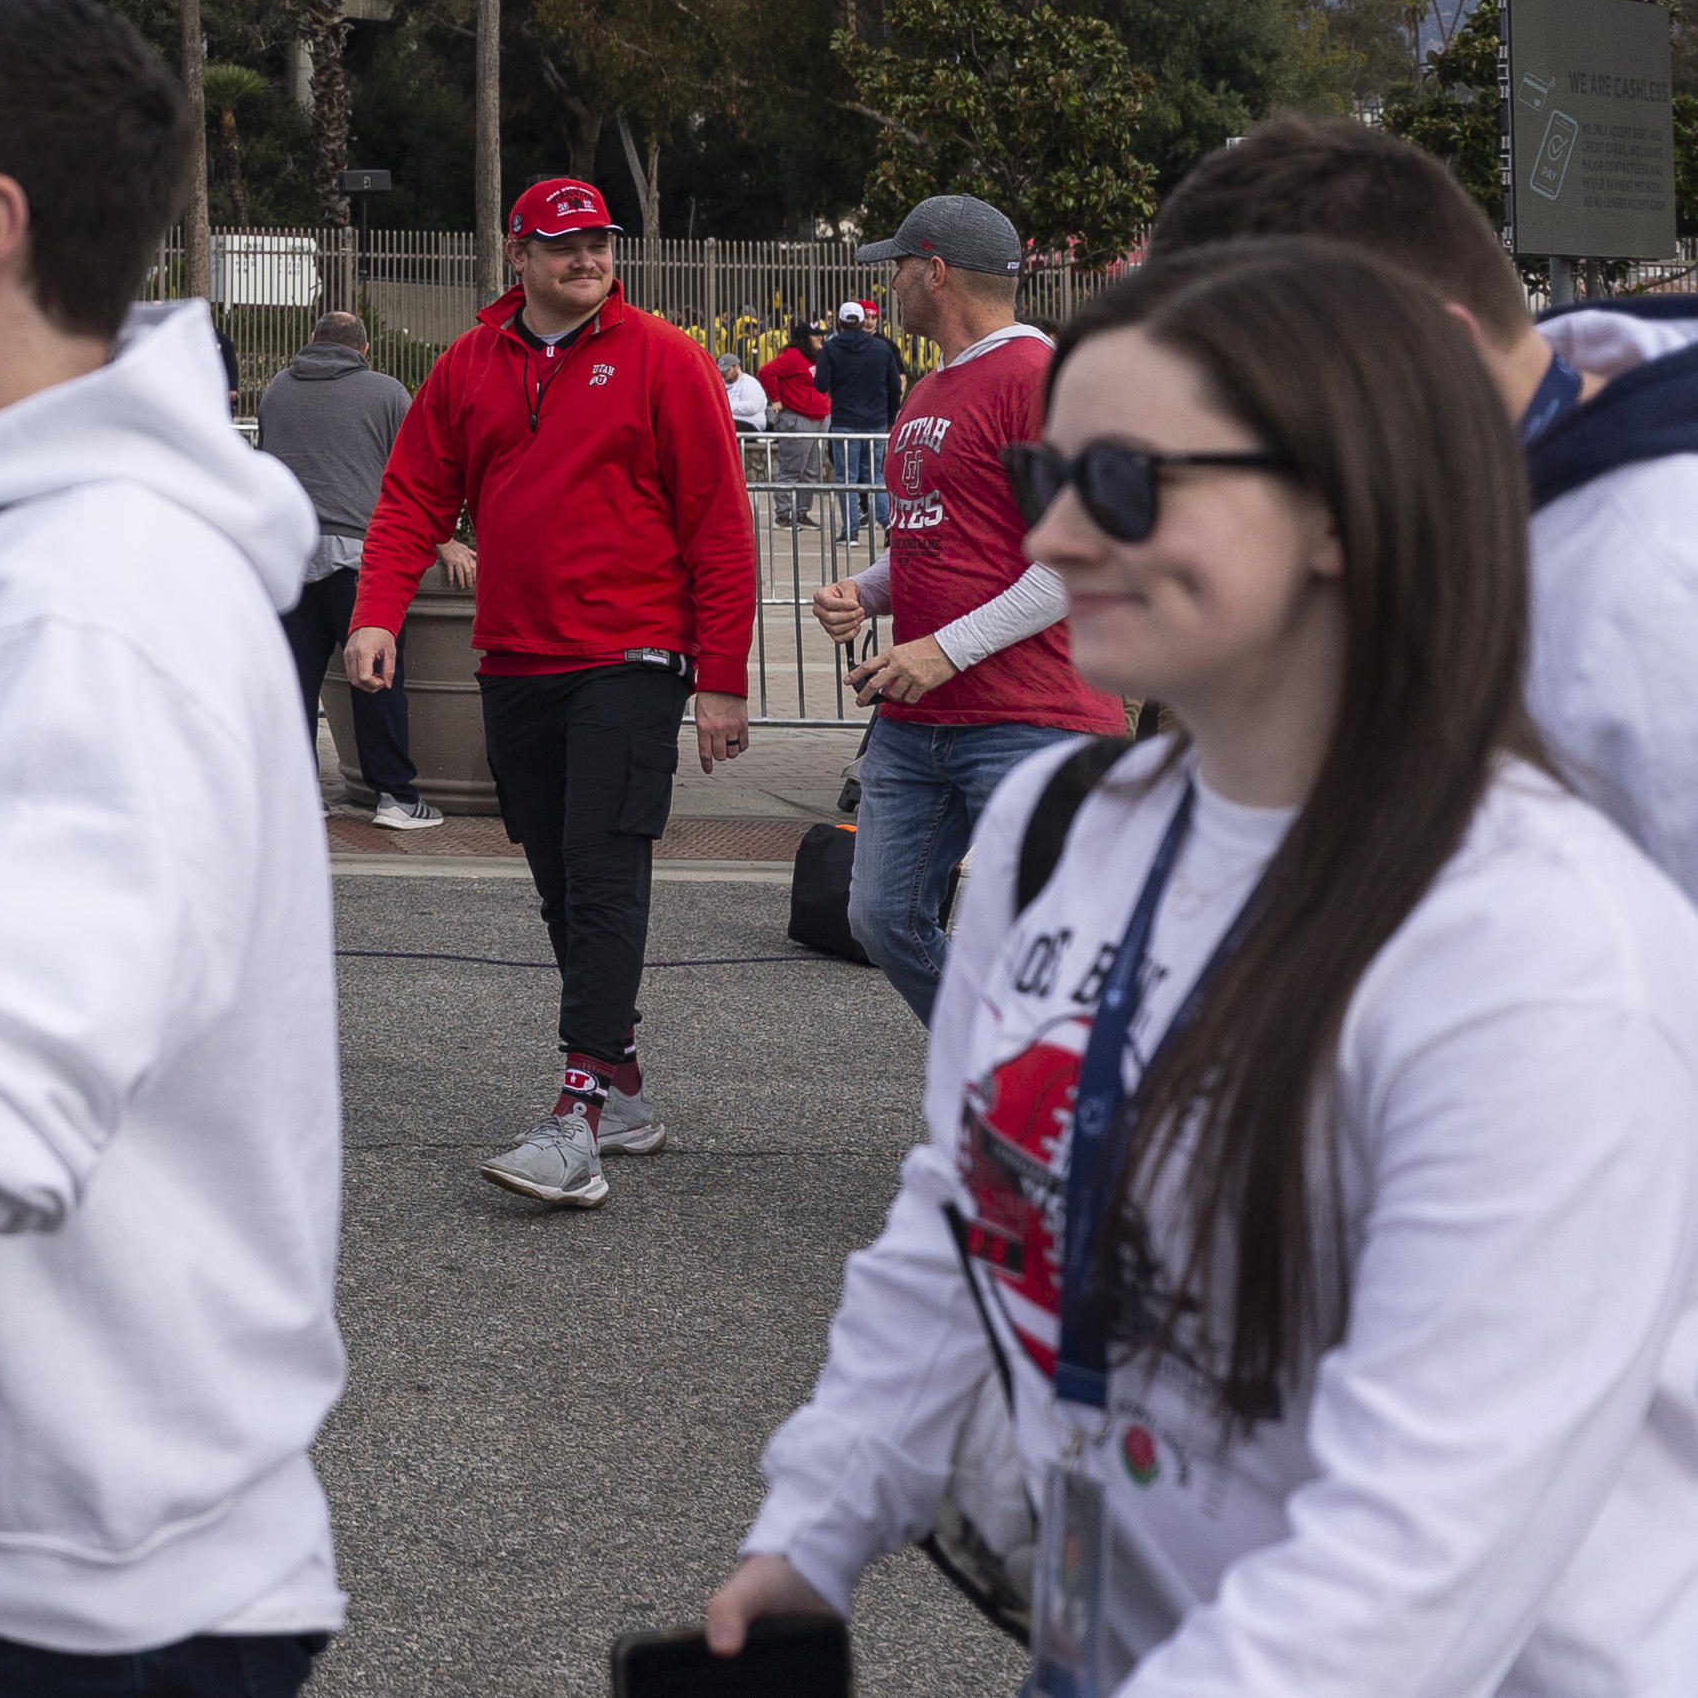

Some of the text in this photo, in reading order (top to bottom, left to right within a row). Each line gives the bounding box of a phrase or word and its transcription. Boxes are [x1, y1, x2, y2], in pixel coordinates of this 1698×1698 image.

[1568, 70, 1668, 103] WE ARE CASHLESS
[1541, 165, 1558, 181] PAY
[546, 346, 555, 358] U
[592, 364, 615, 376] UTAH
[894, 416, 951, 455] UTAH
[889, 489, 944, 530] UTES
